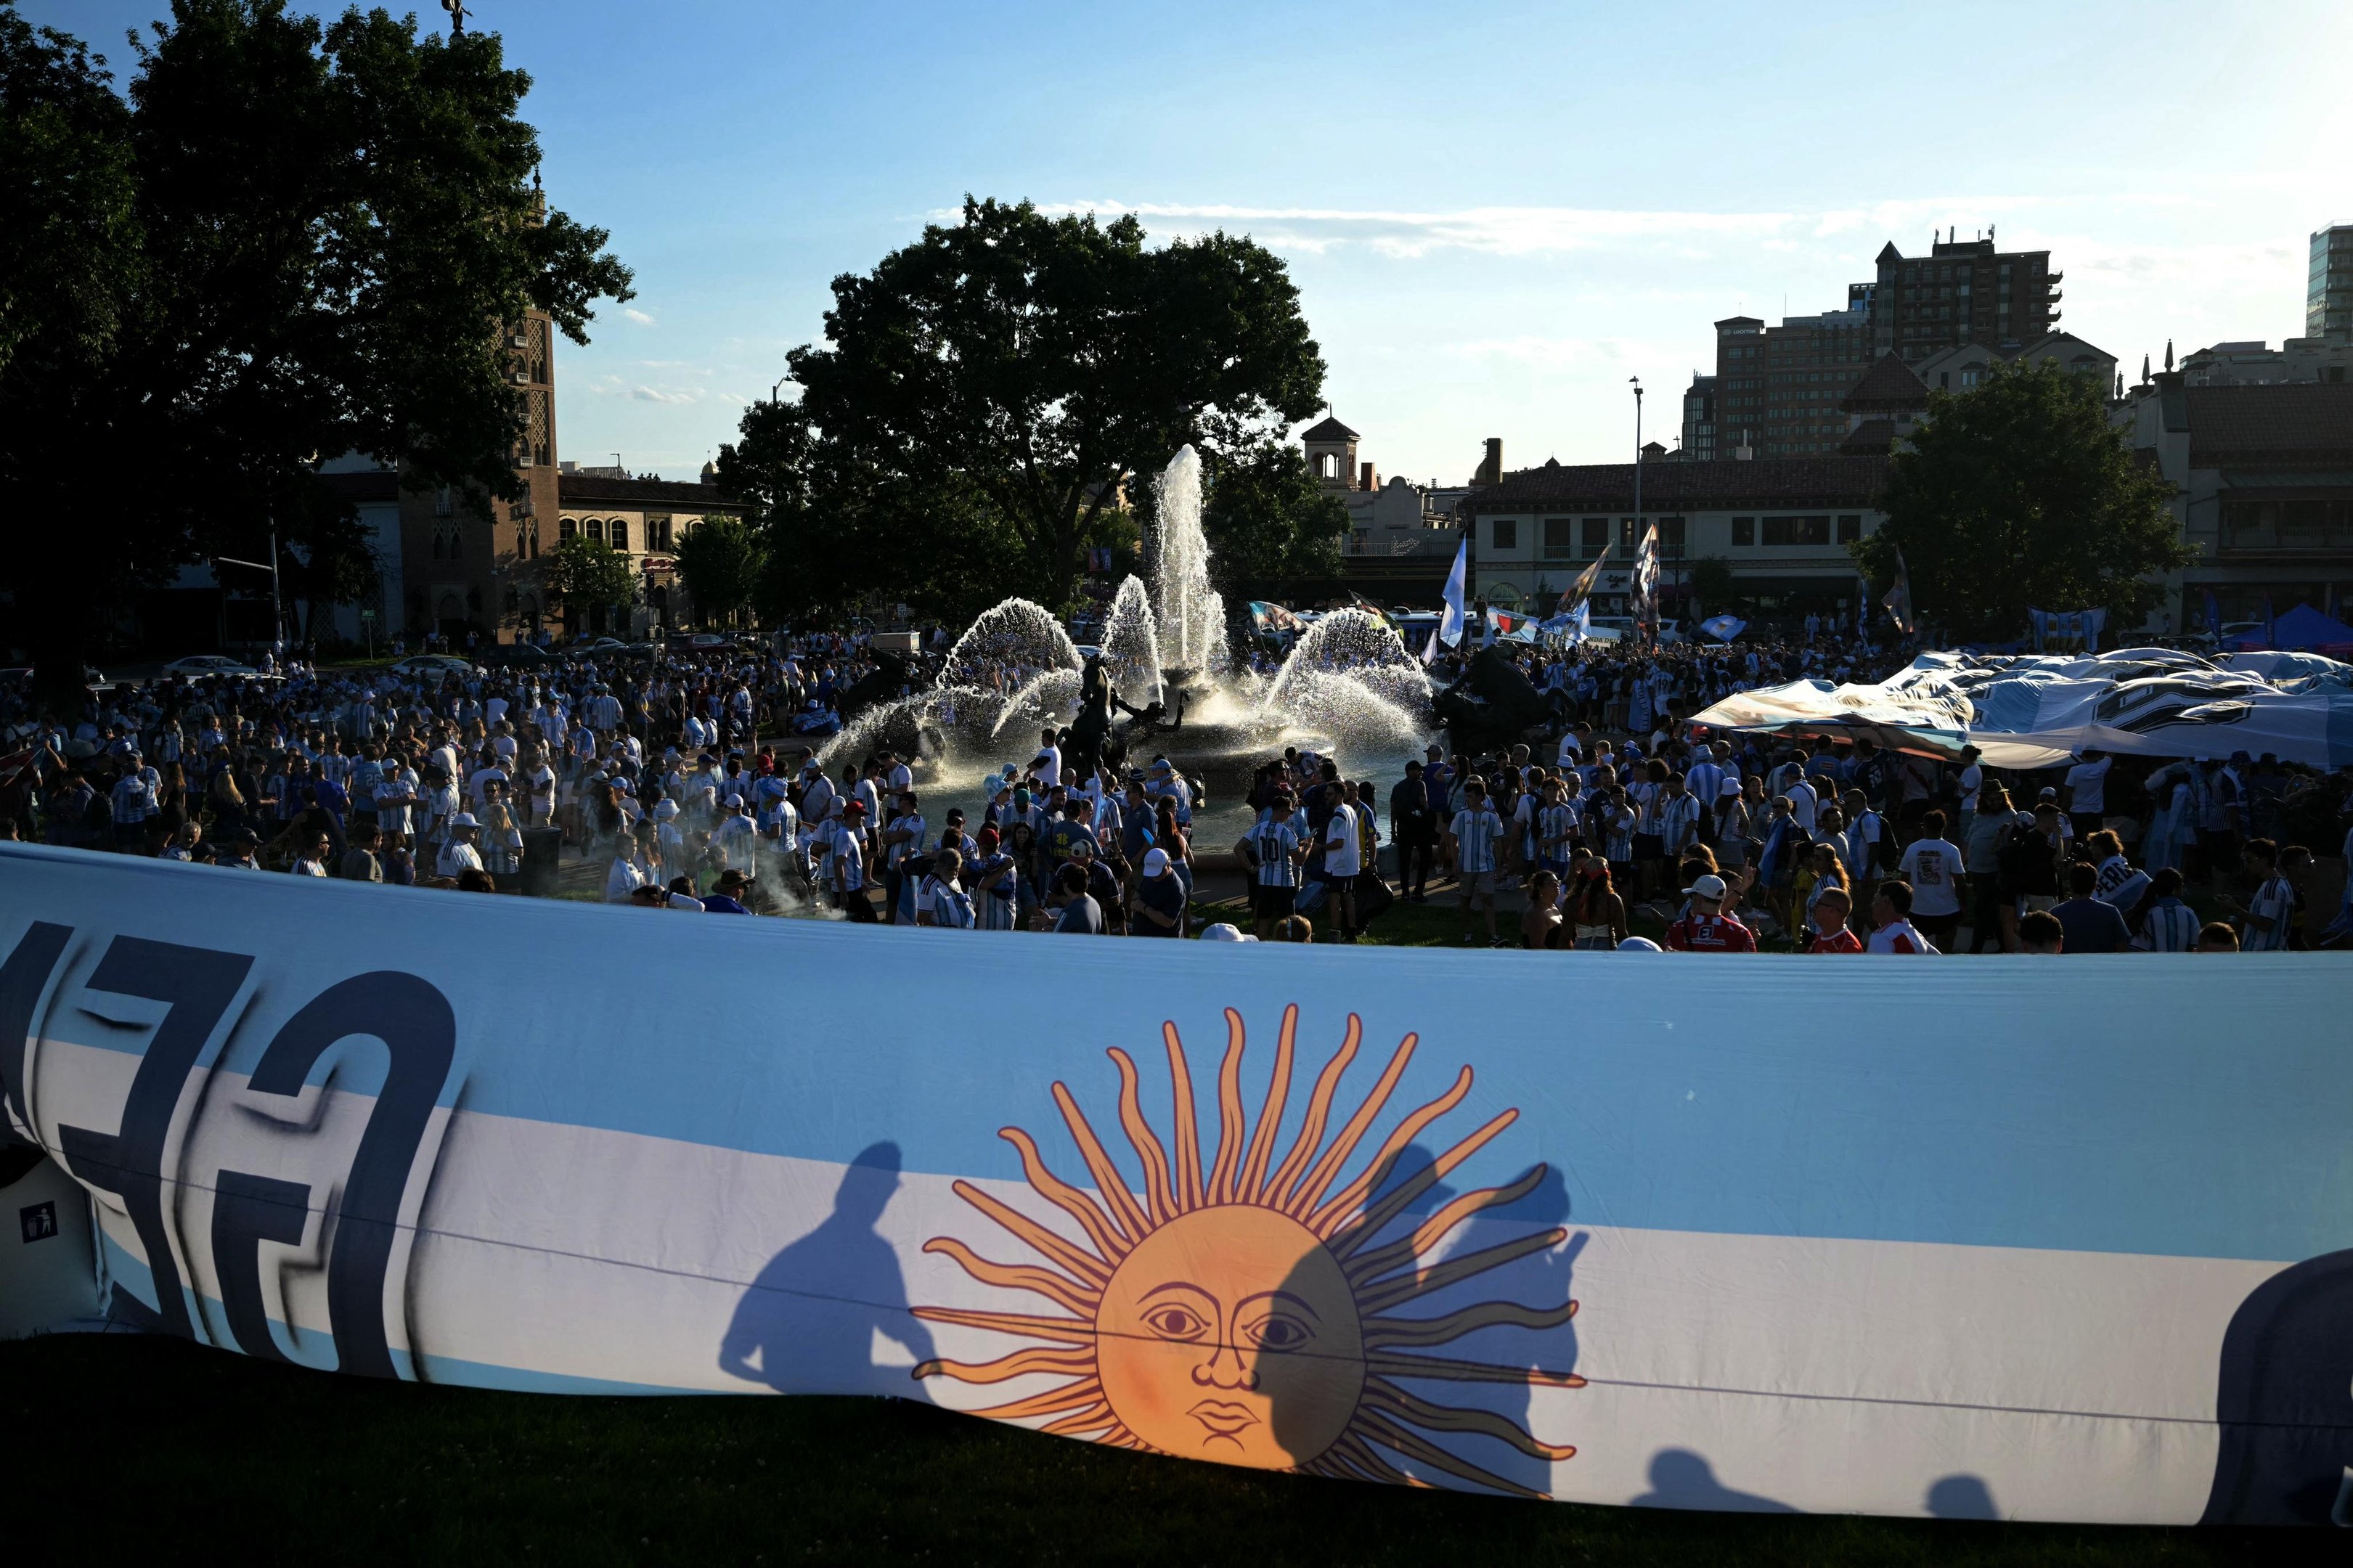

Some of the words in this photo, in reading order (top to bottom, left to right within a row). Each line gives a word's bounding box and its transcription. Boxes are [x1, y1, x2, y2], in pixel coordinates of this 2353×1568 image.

[1605, 574, 1628, 589] rye
[2044, 637, 2087, 651] VILLA
[1657, 679, 1668, 690] 19
[365, 773, 381, 788] 26
[129, 792, 143, 808] 18
[735, 822, 752, 831] MESS
[1260, 836, 1279, 862] 10
[2096, 862, 2137, 898] PERG
